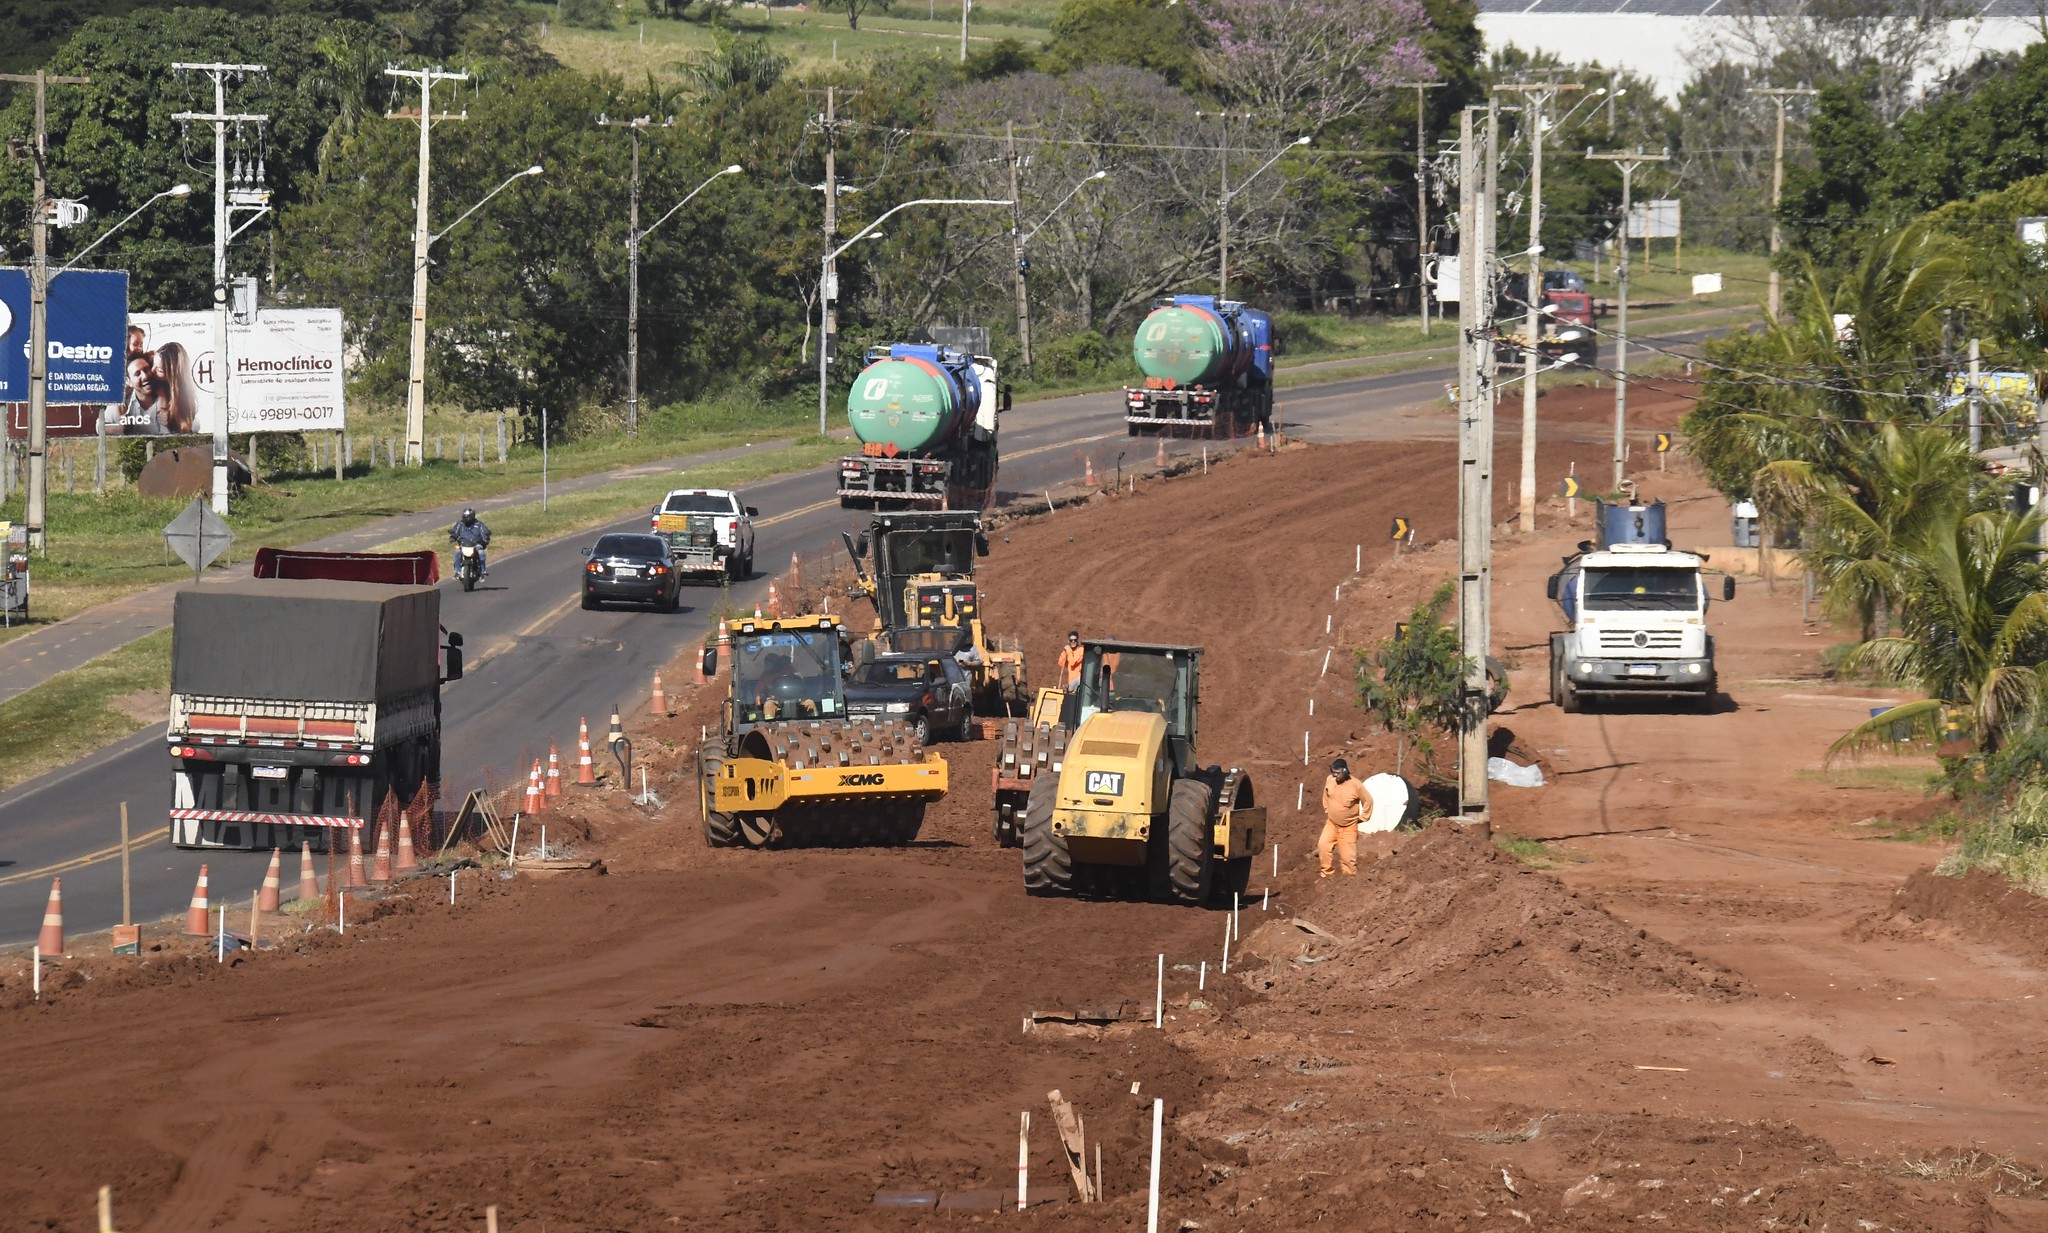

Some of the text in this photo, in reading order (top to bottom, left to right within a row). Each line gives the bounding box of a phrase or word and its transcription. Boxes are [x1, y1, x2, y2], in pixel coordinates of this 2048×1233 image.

[48, 341, 113, 359] Destro
[238, 355, 333, 371] Hemoclínico
[48, 371, 53, 380] É
[64, 372, 85, 380] NOSSA
[48, 381, 53, 390] É
[53, 383, 64, 391] DA
[64, 382, 86, 391] NOSSA
[120, 414, 151, 425] anos
[241, 407, 334, 421] 44 99891-0017
[837, 773, 884, 786] XCMG
[1088, 772, 1122, 794] CAT
